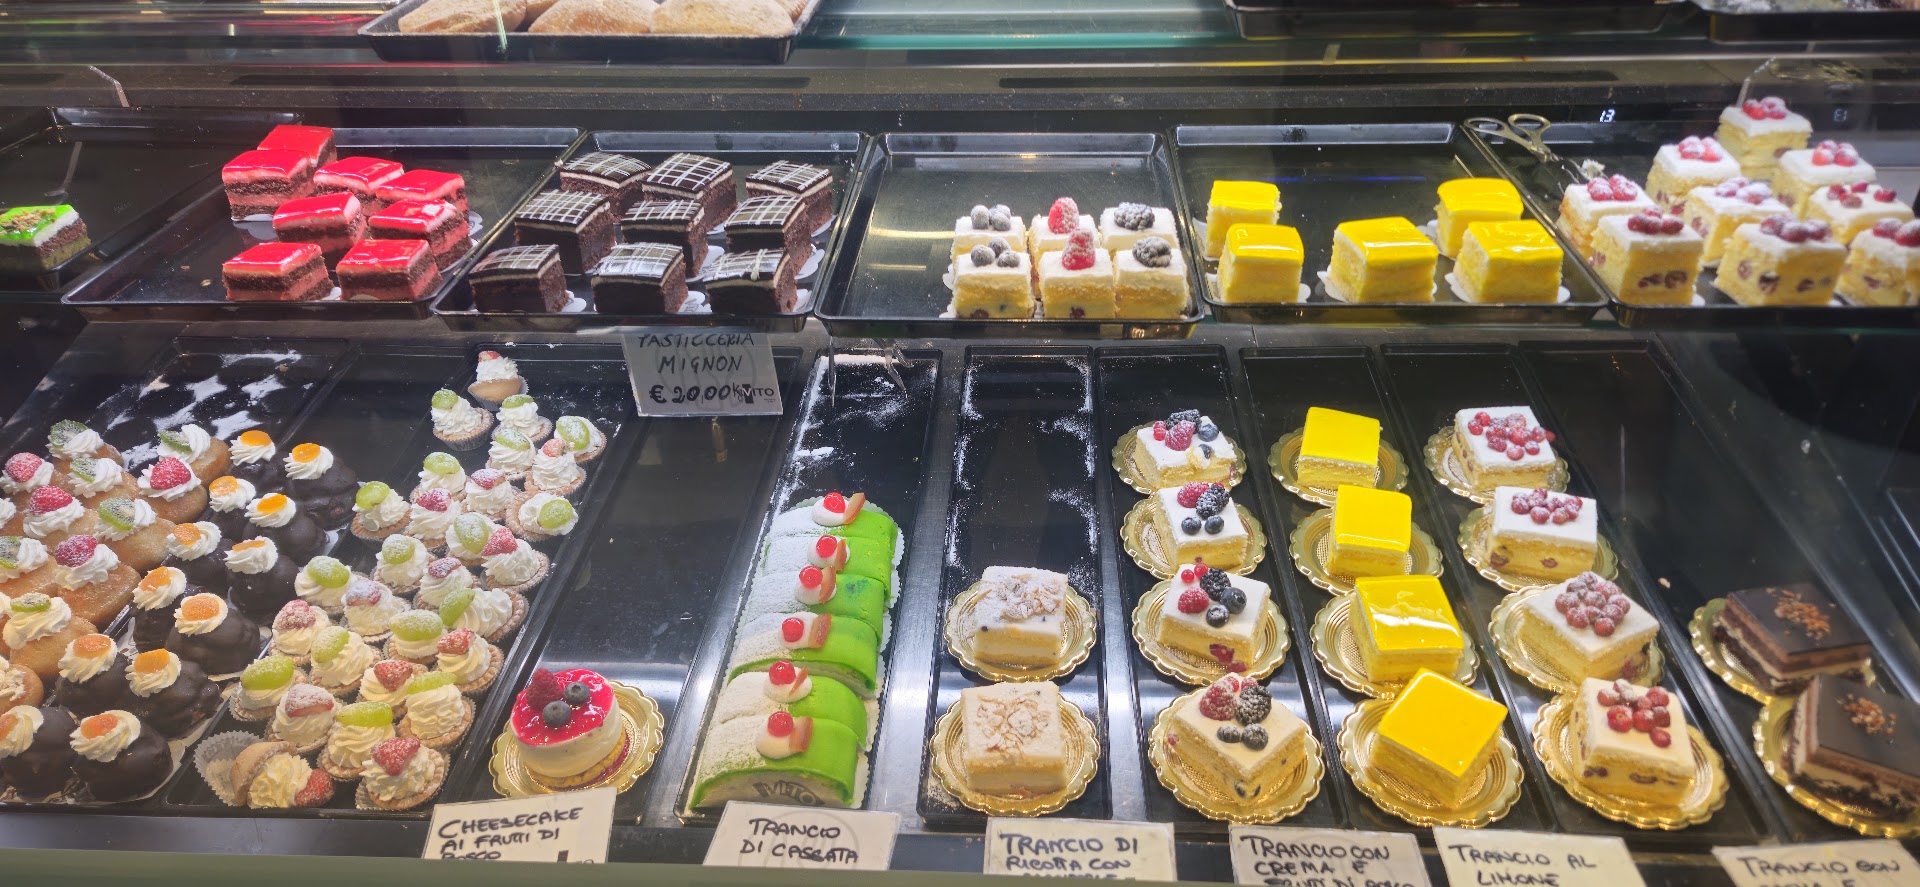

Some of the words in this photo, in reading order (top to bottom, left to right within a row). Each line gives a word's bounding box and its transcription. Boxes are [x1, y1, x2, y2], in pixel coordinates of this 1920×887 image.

[1599, 109, 1616, 122] 13
[658, 354, 743, 374] MIGNON
[438, 807, 584, 839] CHEESECAKE
[749, 817, 842, 840] TRANCIO
[440, 839, 464, 855] AI
[475, 832, 530, 849] FRUTTI
[537, 827, 560, 841] DI
[740, 839, 763, 854] DI
[997, 831, 1104, 856] TRANCIO
[1114, 837, 1139, 854] DI
[1239, 834, 1347, 859] TRANCIO
[1350, 844, 1391, 861] CON
[1006, 856, 1083, 871] RICOTTA
[1088, 857, 1132, 871] CON
[1254, 860, 1335, 877] CREMA
[1351, 860, 1369, 875] E
[1448, 844, 1551, 866] TRANCIO
[1567, 853, 1598, 870] AL
[1736, 855, 1849, 878] TRANCIO
[1477, 869, 1560, 887] LIMONE
